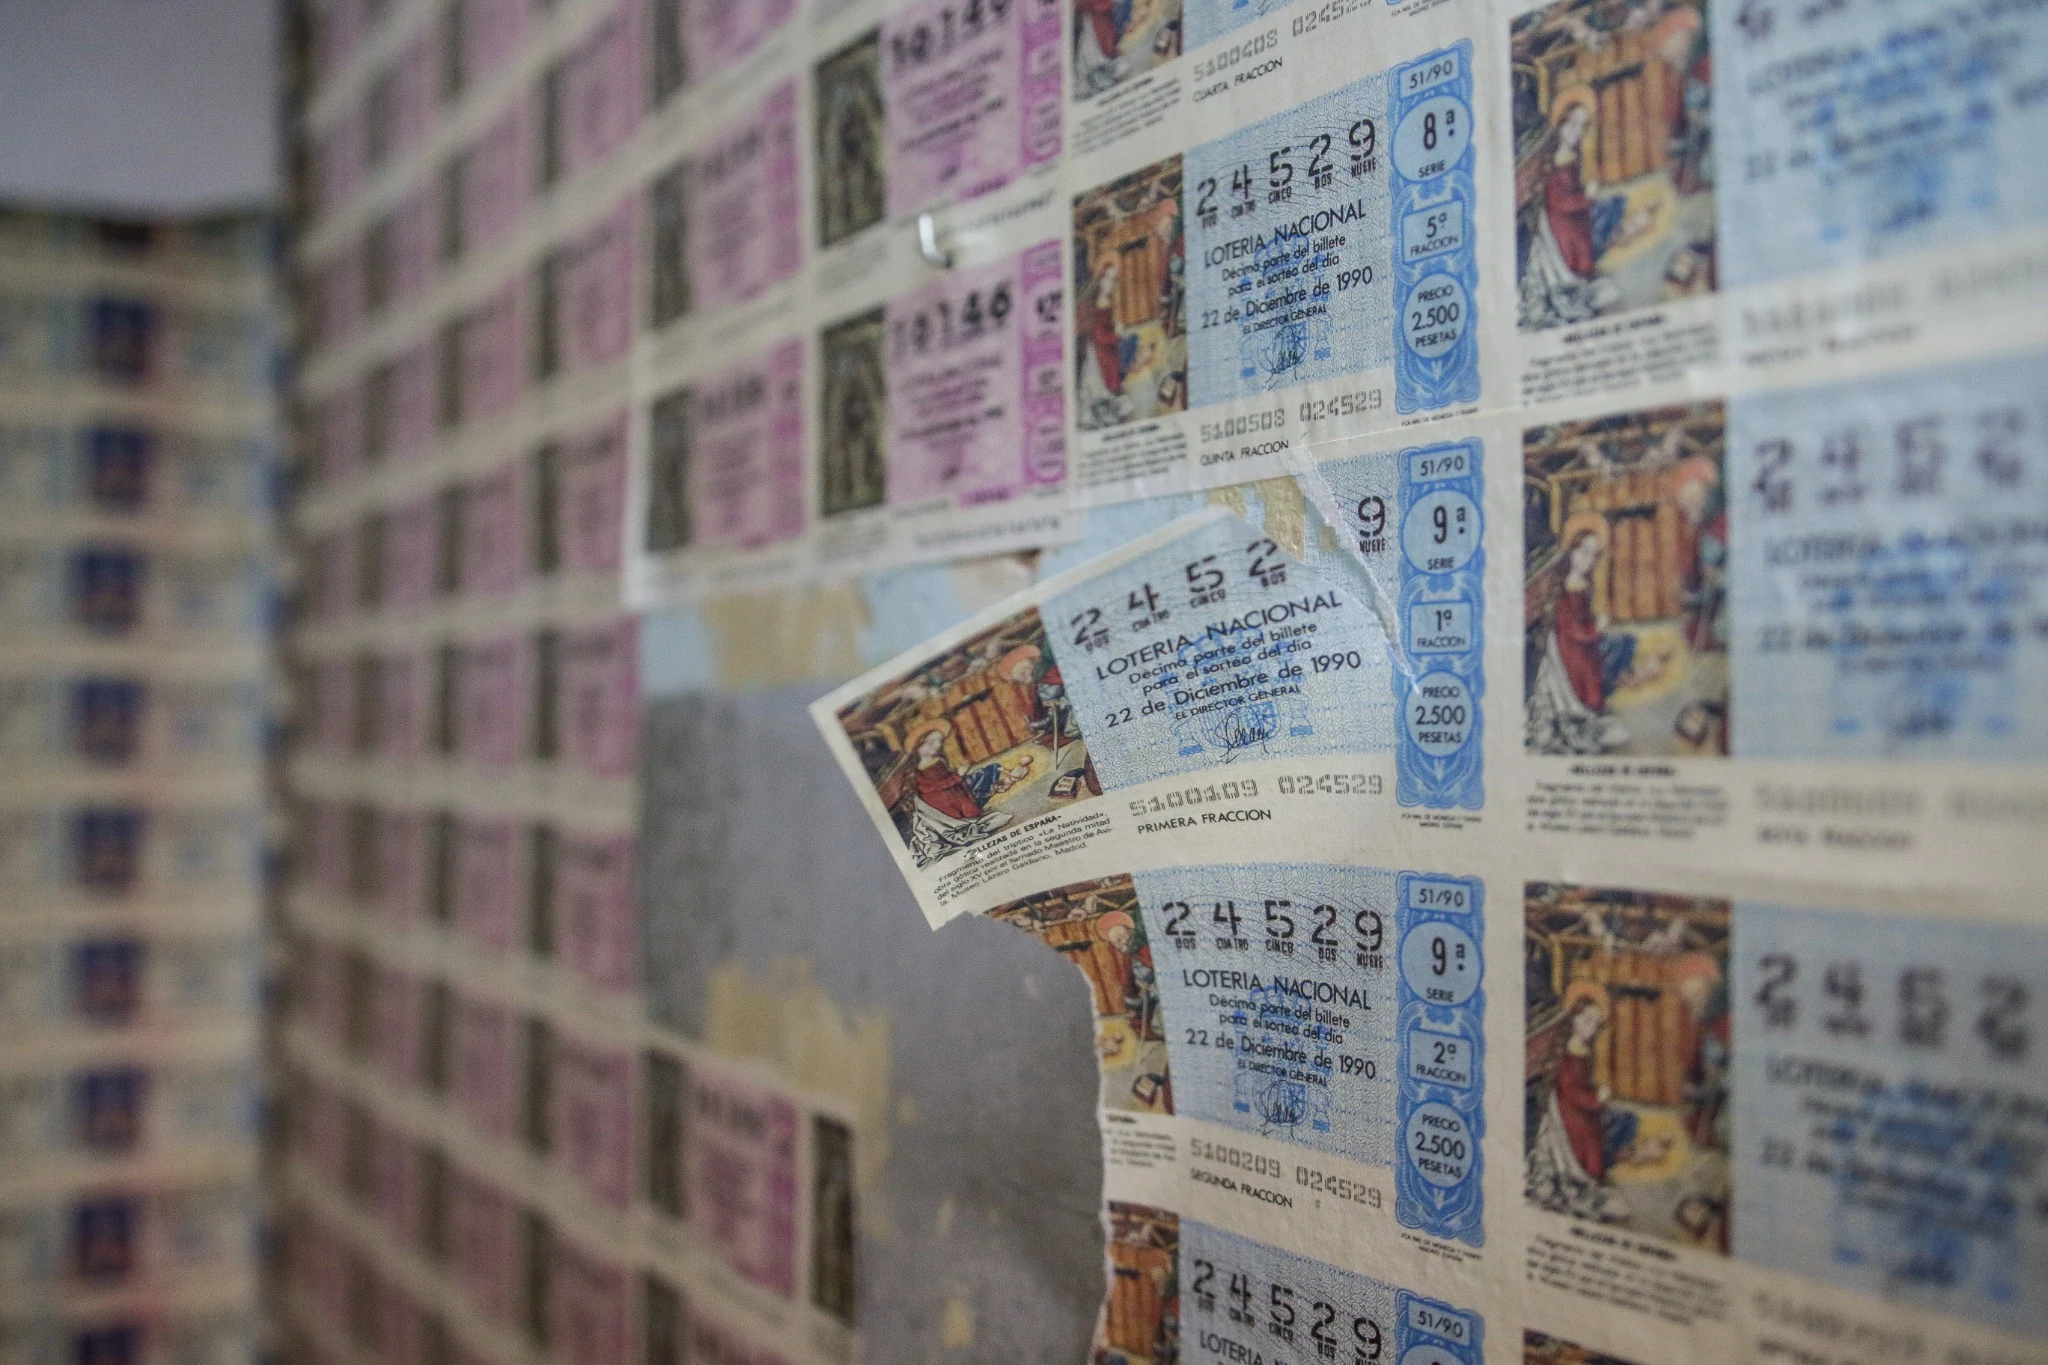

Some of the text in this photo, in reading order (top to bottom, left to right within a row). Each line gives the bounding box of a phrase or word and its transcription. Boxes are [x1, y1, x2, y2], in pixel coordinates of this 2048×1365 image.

[1409, 60, 1453, 89] 51/90
[1418, 159, 1446, 178] SERIE
[1204, 234, 1266, 268] LOTERIA
[1274, 199, 1367, 245] NACIONAL
[1221, 235, 1346, 281] Décima parte del billete
[1228, 252, 1340, 297] para el sorteo del día
[1201, 265, 1373, 329] 22 de Diciembre de 1990
[1417, 284, 1454, 303] PRECIO
[1411, 302, 1460, 332] 2.500
[1415, 329, 1457, 348] PESETAS
[1299, 389, 1382, 422] 024529
[1420, 455, 1464, 476] 51/90
[1358, 495, 1386, 538] 9
[1427, 556, 1455, 570] SERIE
[1096, 634, 1194, 680] LOTERIA
[1205, 590, 1342, 640] NACIONAL
[1194, 645, 1236, 665] parte
[1242, 632, 1264, 650] del
[1270, 623, 1317, 641] billete
[1142, 675, 1178, 696] para
[1186, 665, 1199, 679] el
[1202, 656, 1251, 674] sorteo
[1257, 643, 1280, 660] del
[1105, 650, 1361, 728] 22 de Diciembre de 1990
[1175, 684, 1301, 720] EL DIRECTOR GENERAL
[1422, 686, 1460, 698] PRECIO
[1415, 705, 1465, 725] 2.500
[1419, 731, 1462, 744] PESETAS
[1277, 774, 1383, 795] 024529
[1010, 828, 1022, 838] DE
[1137, 809, 1272, 834] PRIMERA FRACCION
[939, 858, 984, 882] Fragmento
[987, 849, 1000, 859] del
[1418, 888, 1464, 908] 51/90
[1183, 969, 1371, 1010] LOTERIA NACIONAL
[1426, 987, 1454, 1002] SERIE
[1209, 994, 1350, 1028] Décima parte del billete
[1219, 1014, 1247, 1026] para
[1253, 1015, 1262, 1028] el
[1265, 1019, 1299, 1035] sorteo
[1303, 1024, 1321, 1040] del
[1186, 1028, 1208, 1046] 22
[1216, 1032, 1235, 1049] de
[1241, 1035, 1307, 1064] Diciembre
[1314, 1050, 1333, 1069] de
[1339, 1055, 1376, 1079] 1990
[1422, 1113, 1461, 1132] PRECIO
[1415, 1131, 1466, 1160] 2.500
[1418, 1157, 1463, 1179] PESETAS
[1296, 1166, 1381, 1208] 024529
[1417, 1310, 1464, 1338] 51/90
